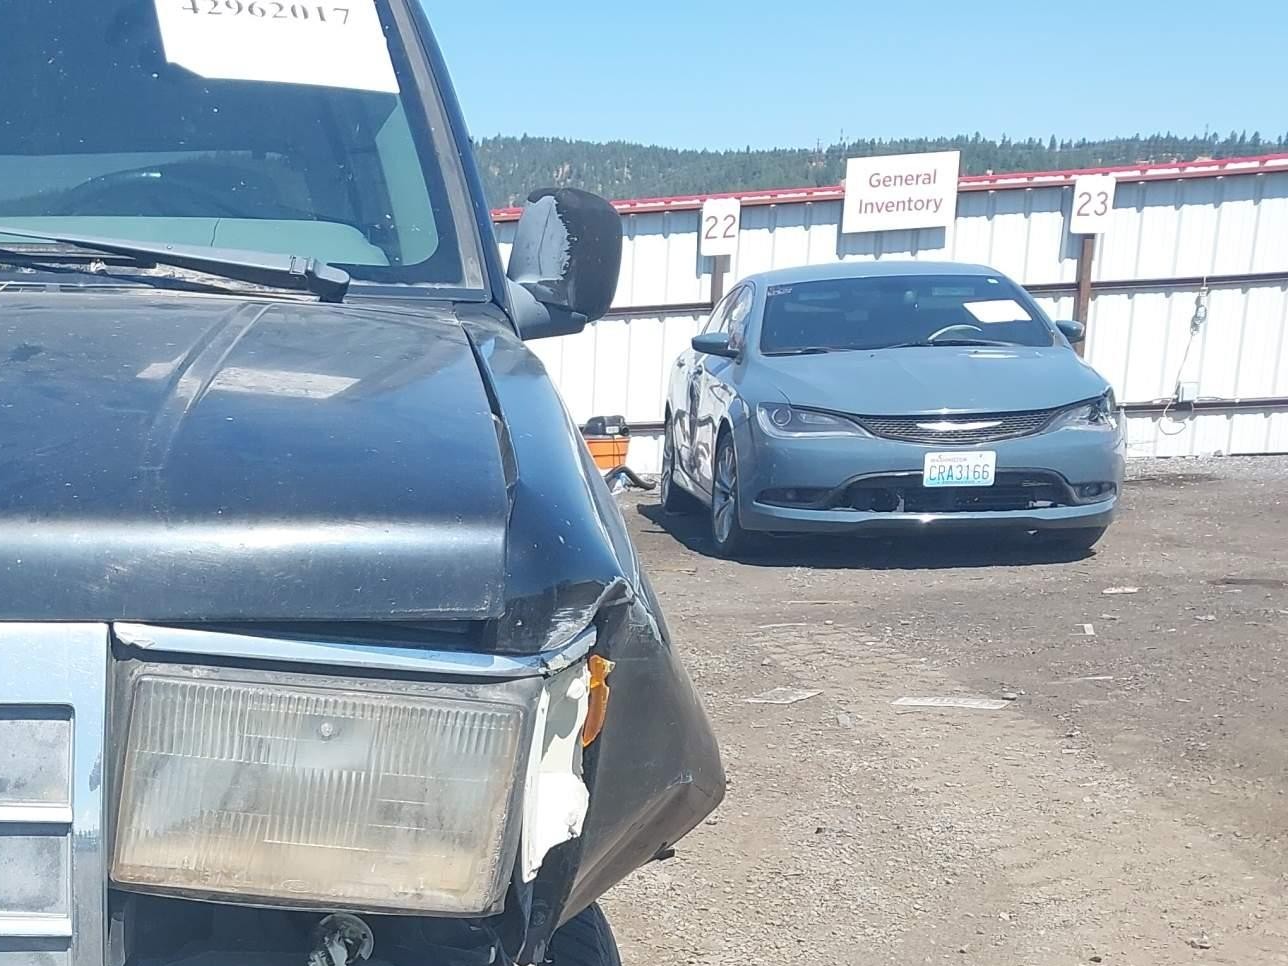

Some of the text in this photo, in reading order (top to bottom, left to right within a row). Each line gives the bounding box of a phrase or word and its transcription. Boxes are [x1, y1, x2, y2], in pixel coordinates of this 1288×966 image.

[868, 169, 938, 188] General
[859, 195, 943, 215] Inventory
[1077, 191, 1109, 216] 23
[704, 215, 737, 240] 22
[929, 464, 990, 481] CRA3166
